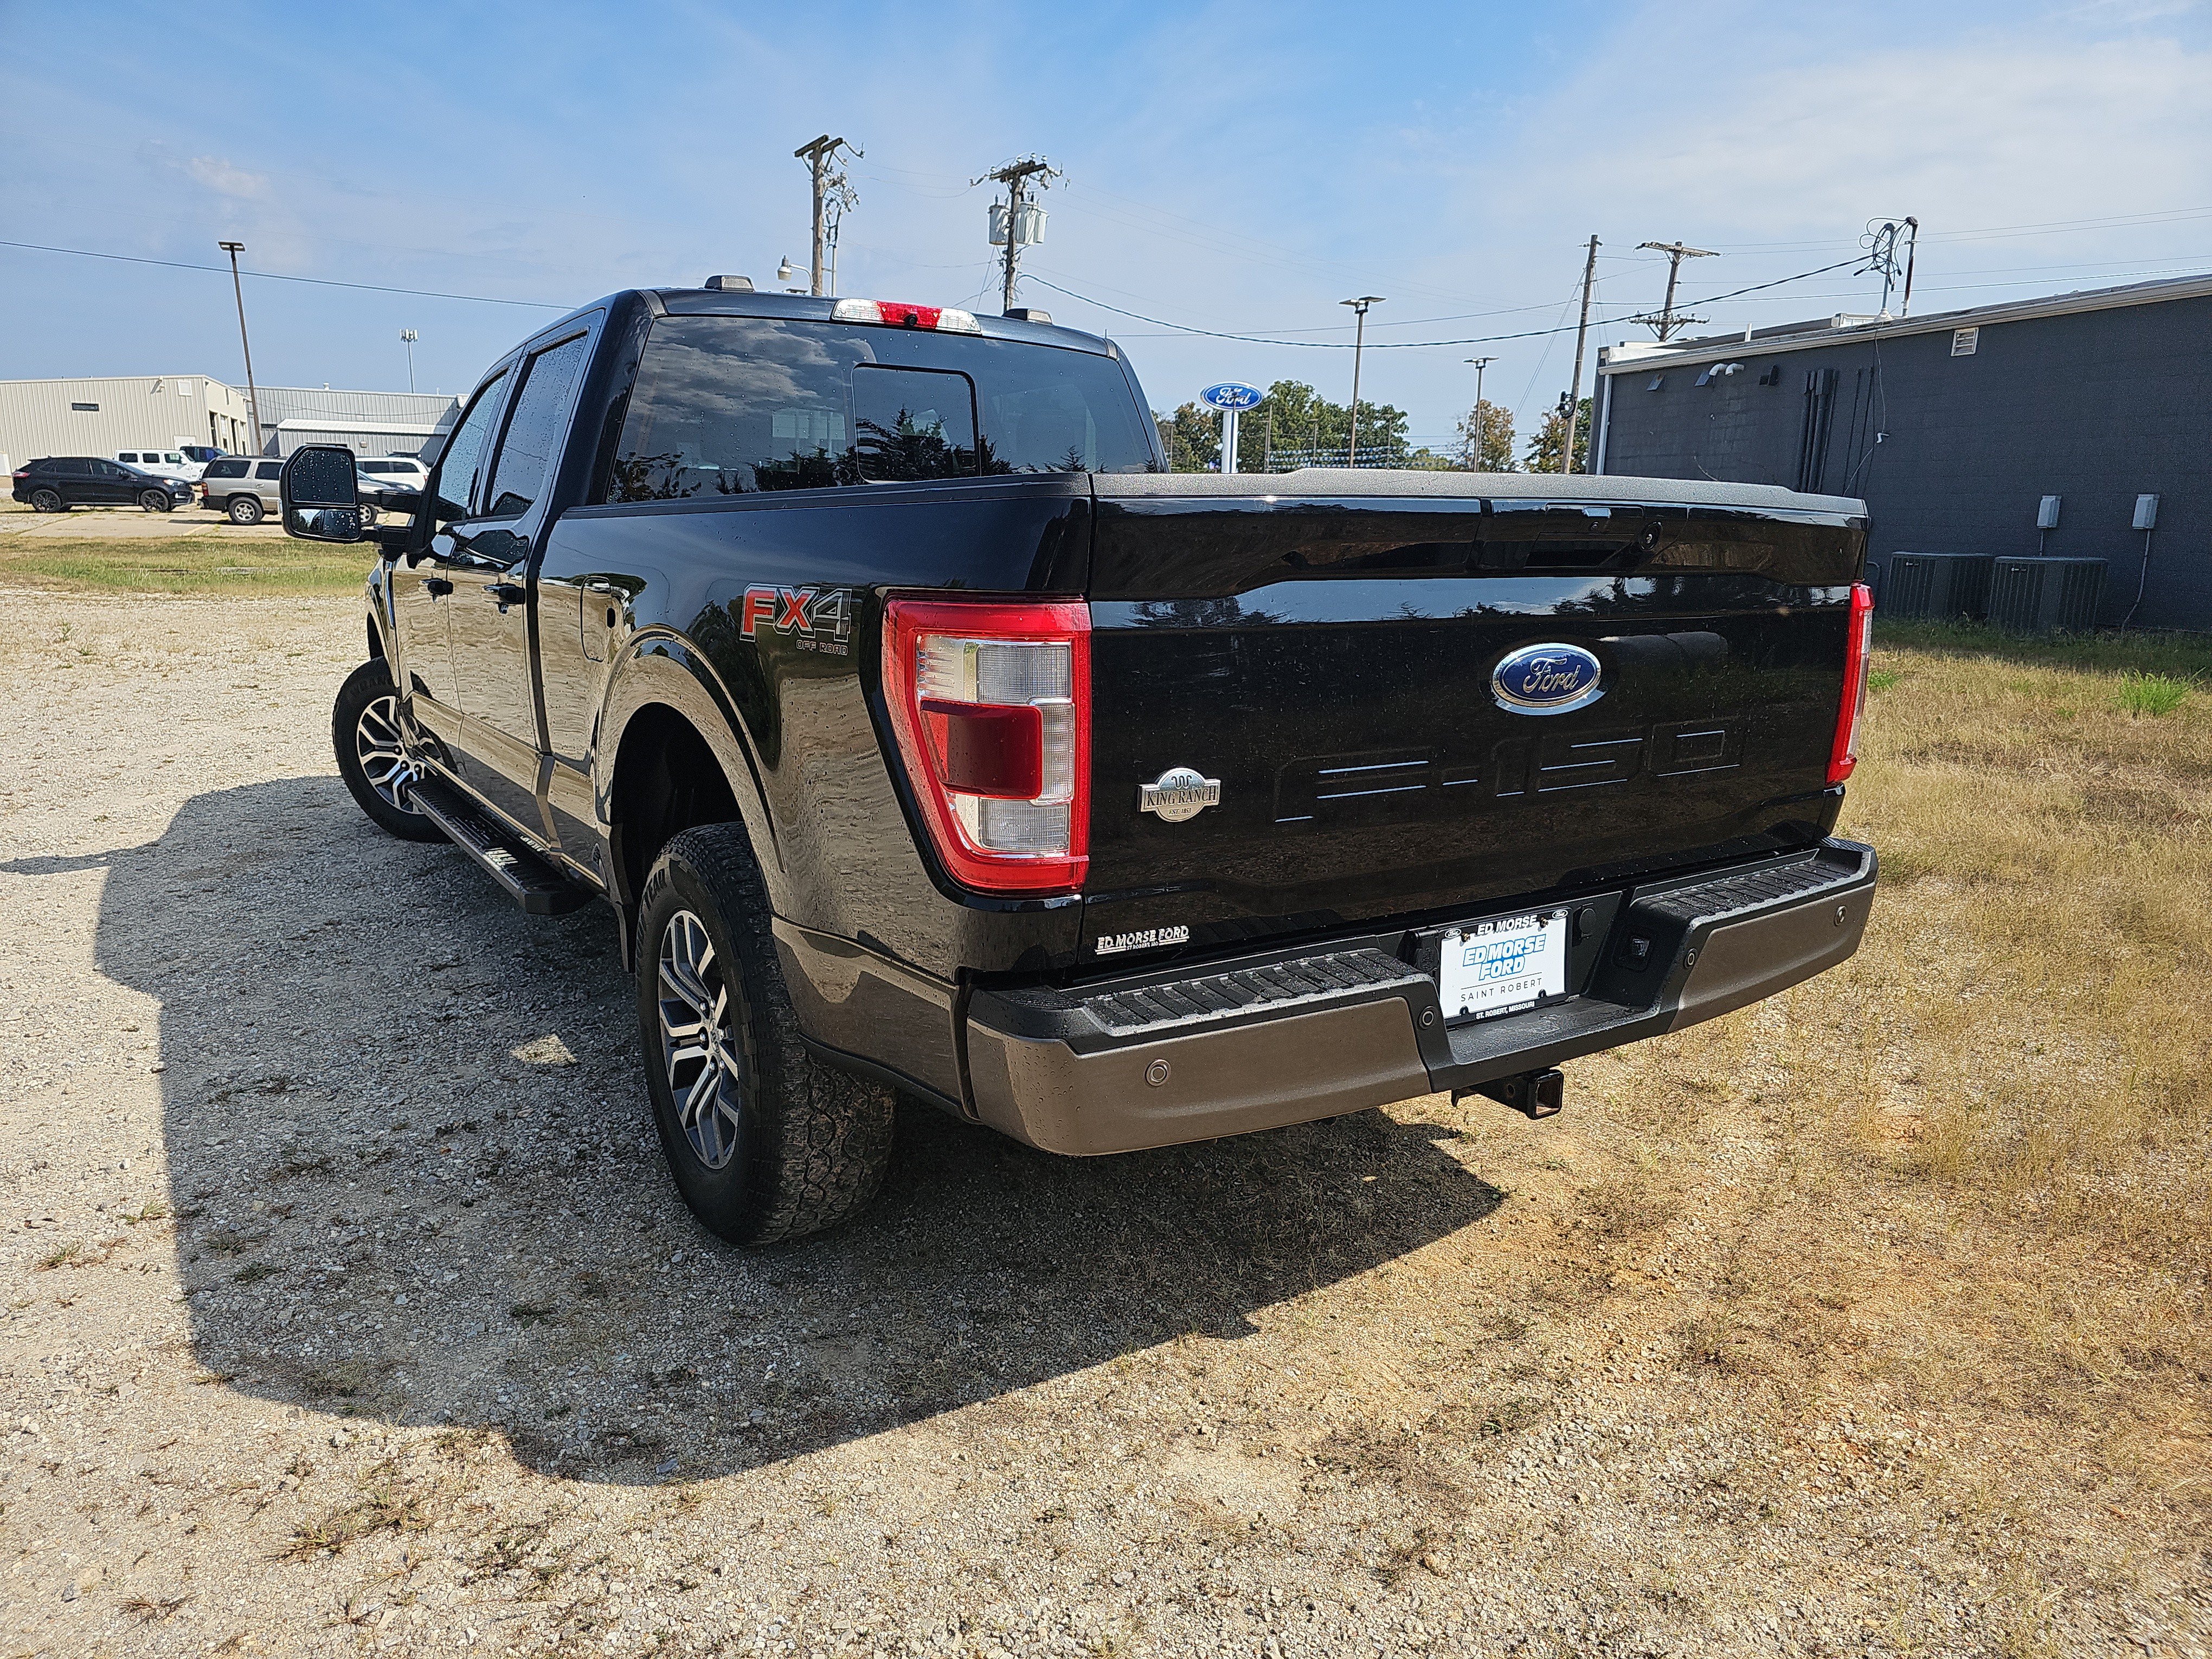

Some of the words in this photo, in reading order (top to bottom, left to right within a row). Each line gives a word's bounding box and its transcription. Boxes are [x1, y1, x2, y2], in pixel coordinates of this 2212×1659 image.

[1216, 387, 1252, 405] Ford
[740, 583, 852, 642] FX4
[796, 640, 816, 651] OFF
[820, 642, 848, 655] ROAD
[1522, 657, 1581, 693] Ford
[1274, 716, 1742, 822] F-150
[1146, 790, 1175, 807] KING
[1178, 786, 1217, 804] RANCH
[1477, 924, 1493, 935] ED
[1496, 915, 1538, 931] MORSE
[1097, 935, 1115, 949] ED
[1116, 929, 1158, 947] MORSE
[1158, 925, 1189, 941] FORD
[1463, 946, 1487, 967] ED
[1487, 934, 1546, 963] MORSE
[1478, 955, 1525, 981] FORD
[1461, 988, 1494, 1001] SAINT
[1500, 978, 1542, 994] ROBERT
[1485, 1007, 1508, 1018] ROBERT,
[1508, 1001, 1535, 1013] MISSOURI
